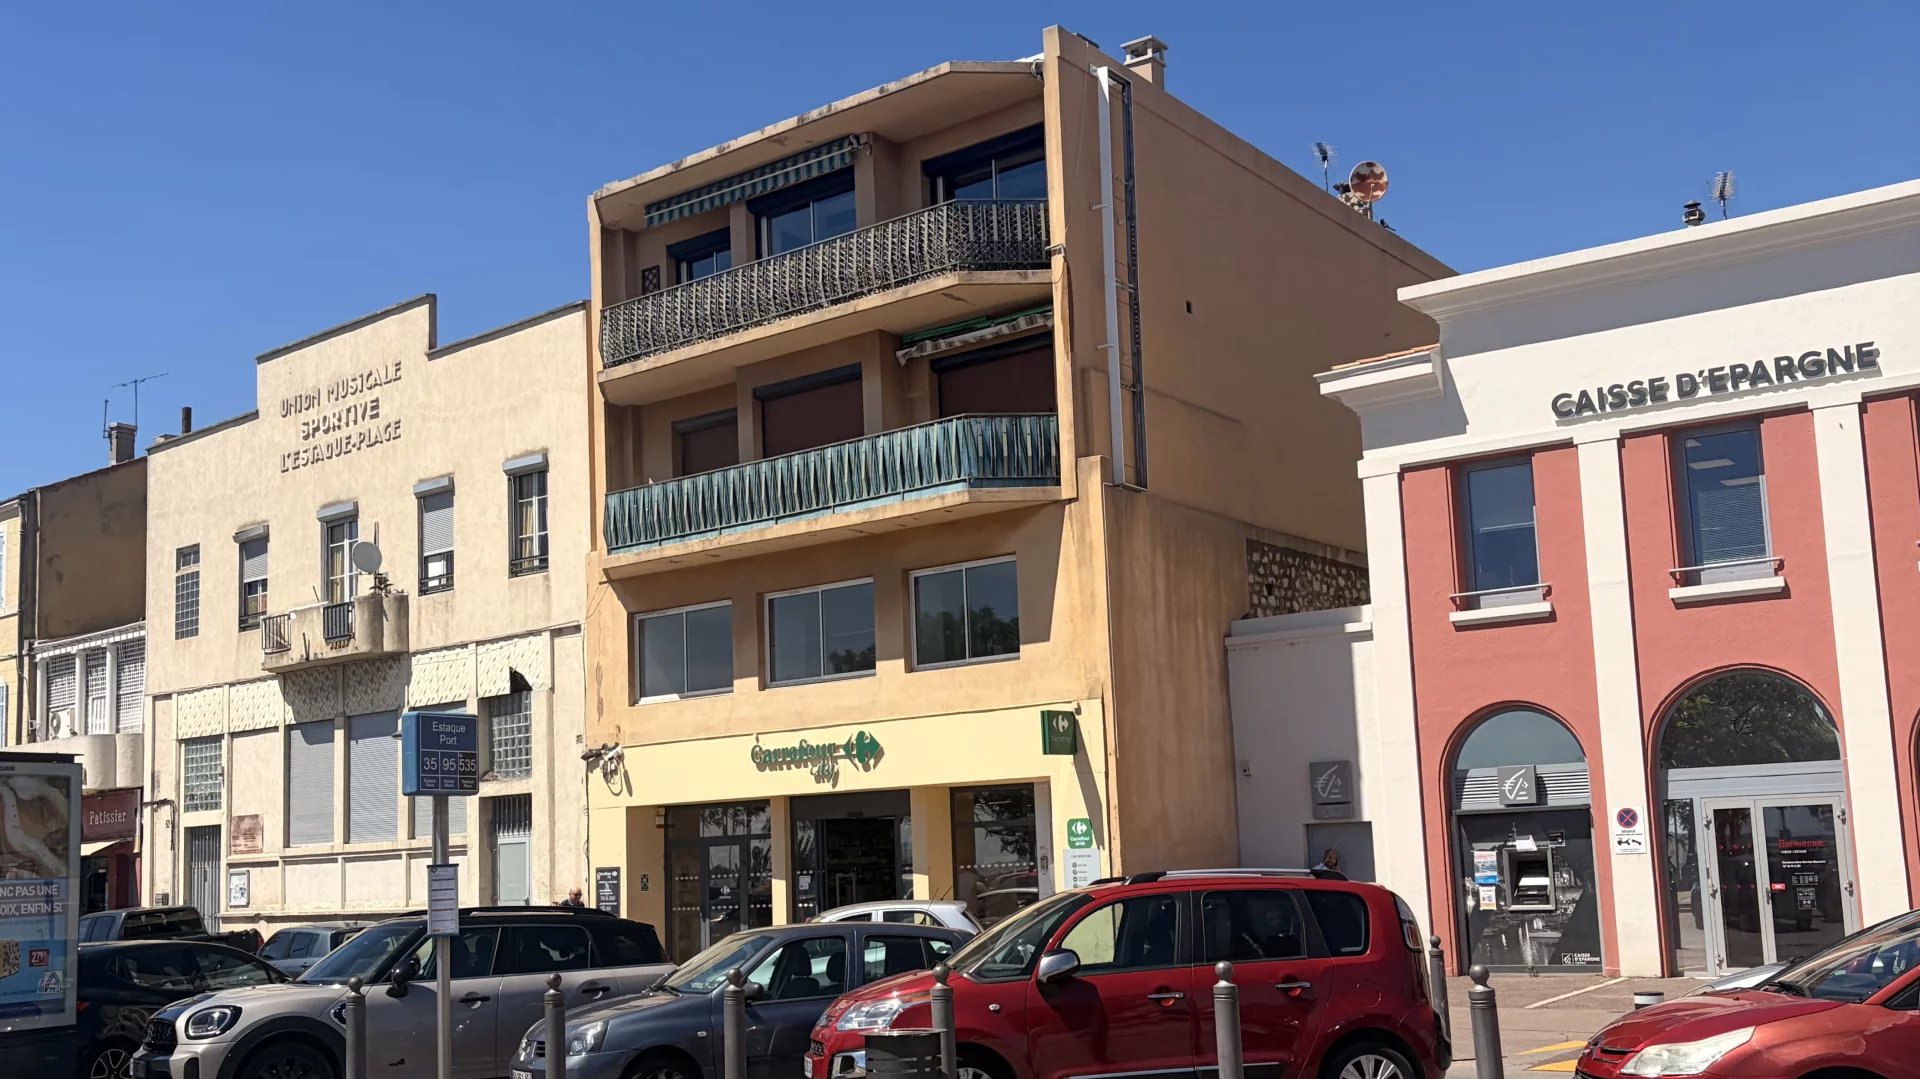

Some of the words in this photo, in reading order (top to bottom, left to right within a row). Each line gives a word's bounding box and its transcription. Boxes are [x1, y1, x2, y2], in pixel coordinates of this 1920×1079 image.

[280, 387, 321, 418] UNION
[327, 360, 402, 404] MUSICALE
[1551, 376, 1667, 419] CAISSE
[1675, 341, 1877, 399] D'EPARGNE
[301, 397, 380, 440] SPORTIVE
[432, 721, 466, 735] Estaque
[440, 734, 457, 745] Port
[751, 739, 837, 765] Carrefour
[423, 757, 438, 770] 35
[442, 758, 456, 771] 95
[459, 758, 476, 772] 535
[810, 758, 835, 781] city
[15, 885, 36, 897] PAS
[37, 884, 58, 896] UNE
[21, 902, 52, 915] ENFIN
